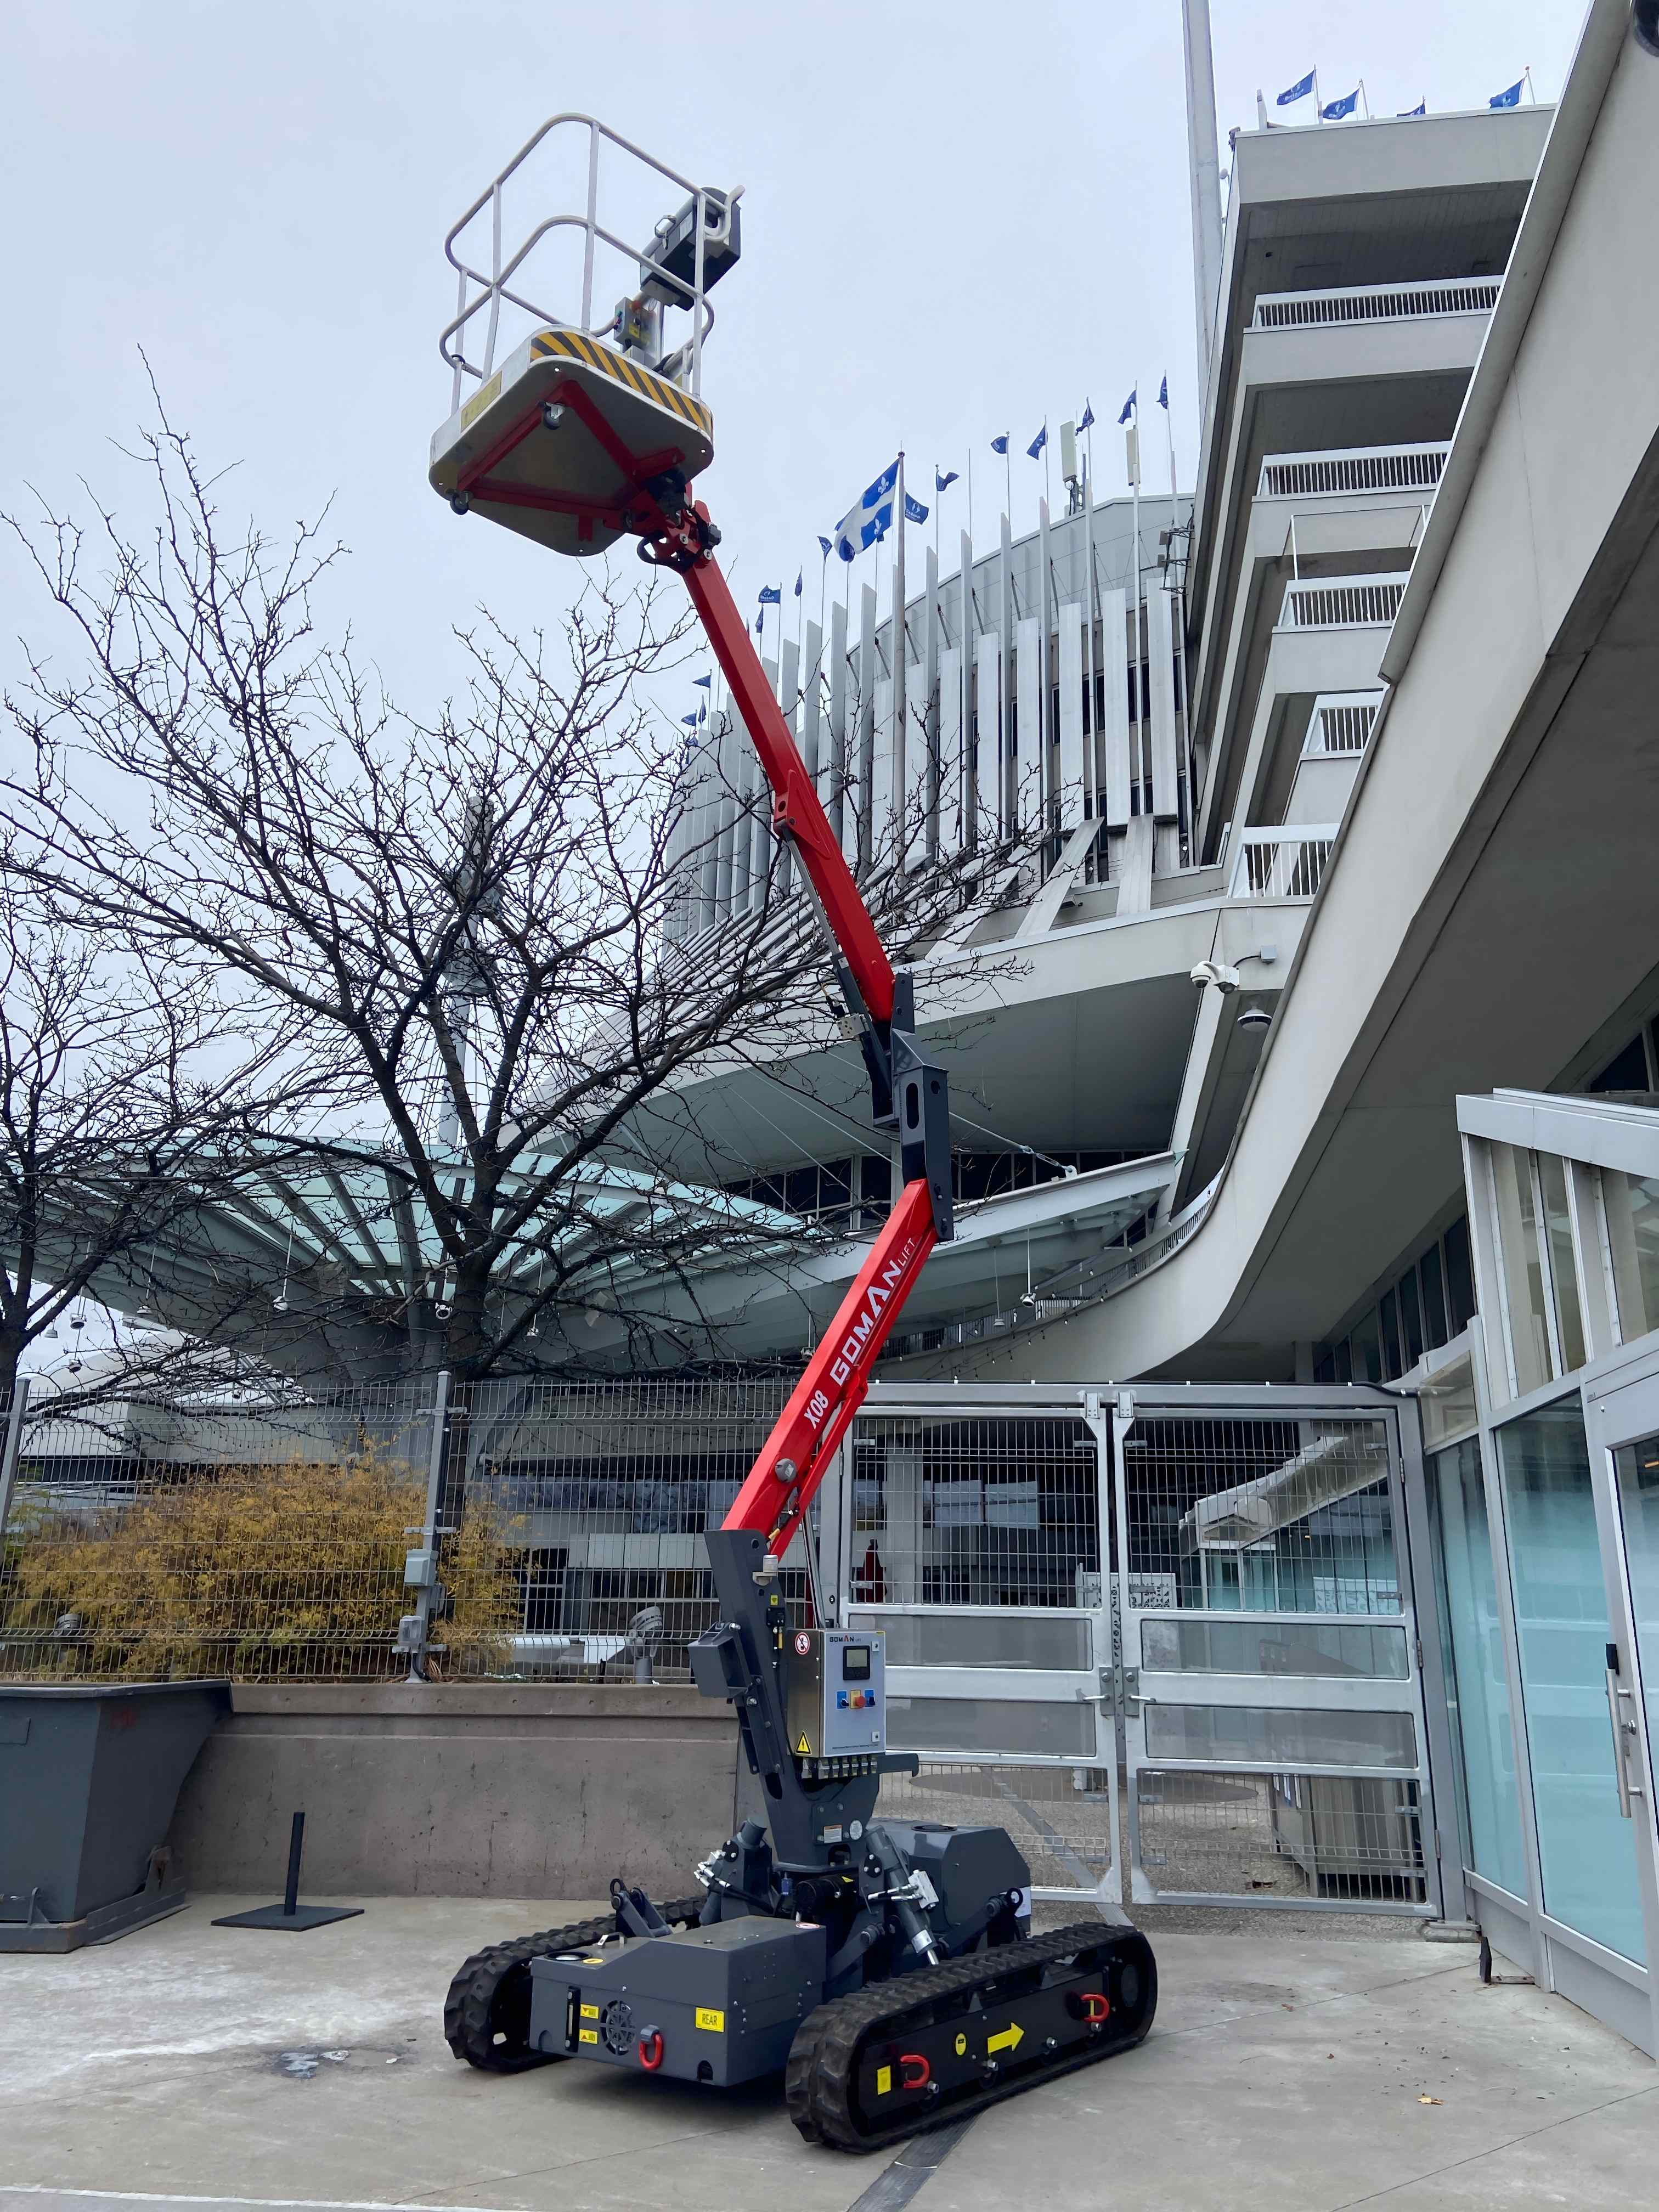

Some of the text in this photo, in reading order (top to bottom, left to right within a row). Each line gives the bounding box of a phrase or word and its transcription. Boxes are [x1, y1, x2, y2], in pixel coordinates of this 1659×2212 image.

[829, 1237, 915, 1387] GOMAN LIFT
[803, 1389, 829, 1429] X08
[702, 2013, 718, 2026] REAR
